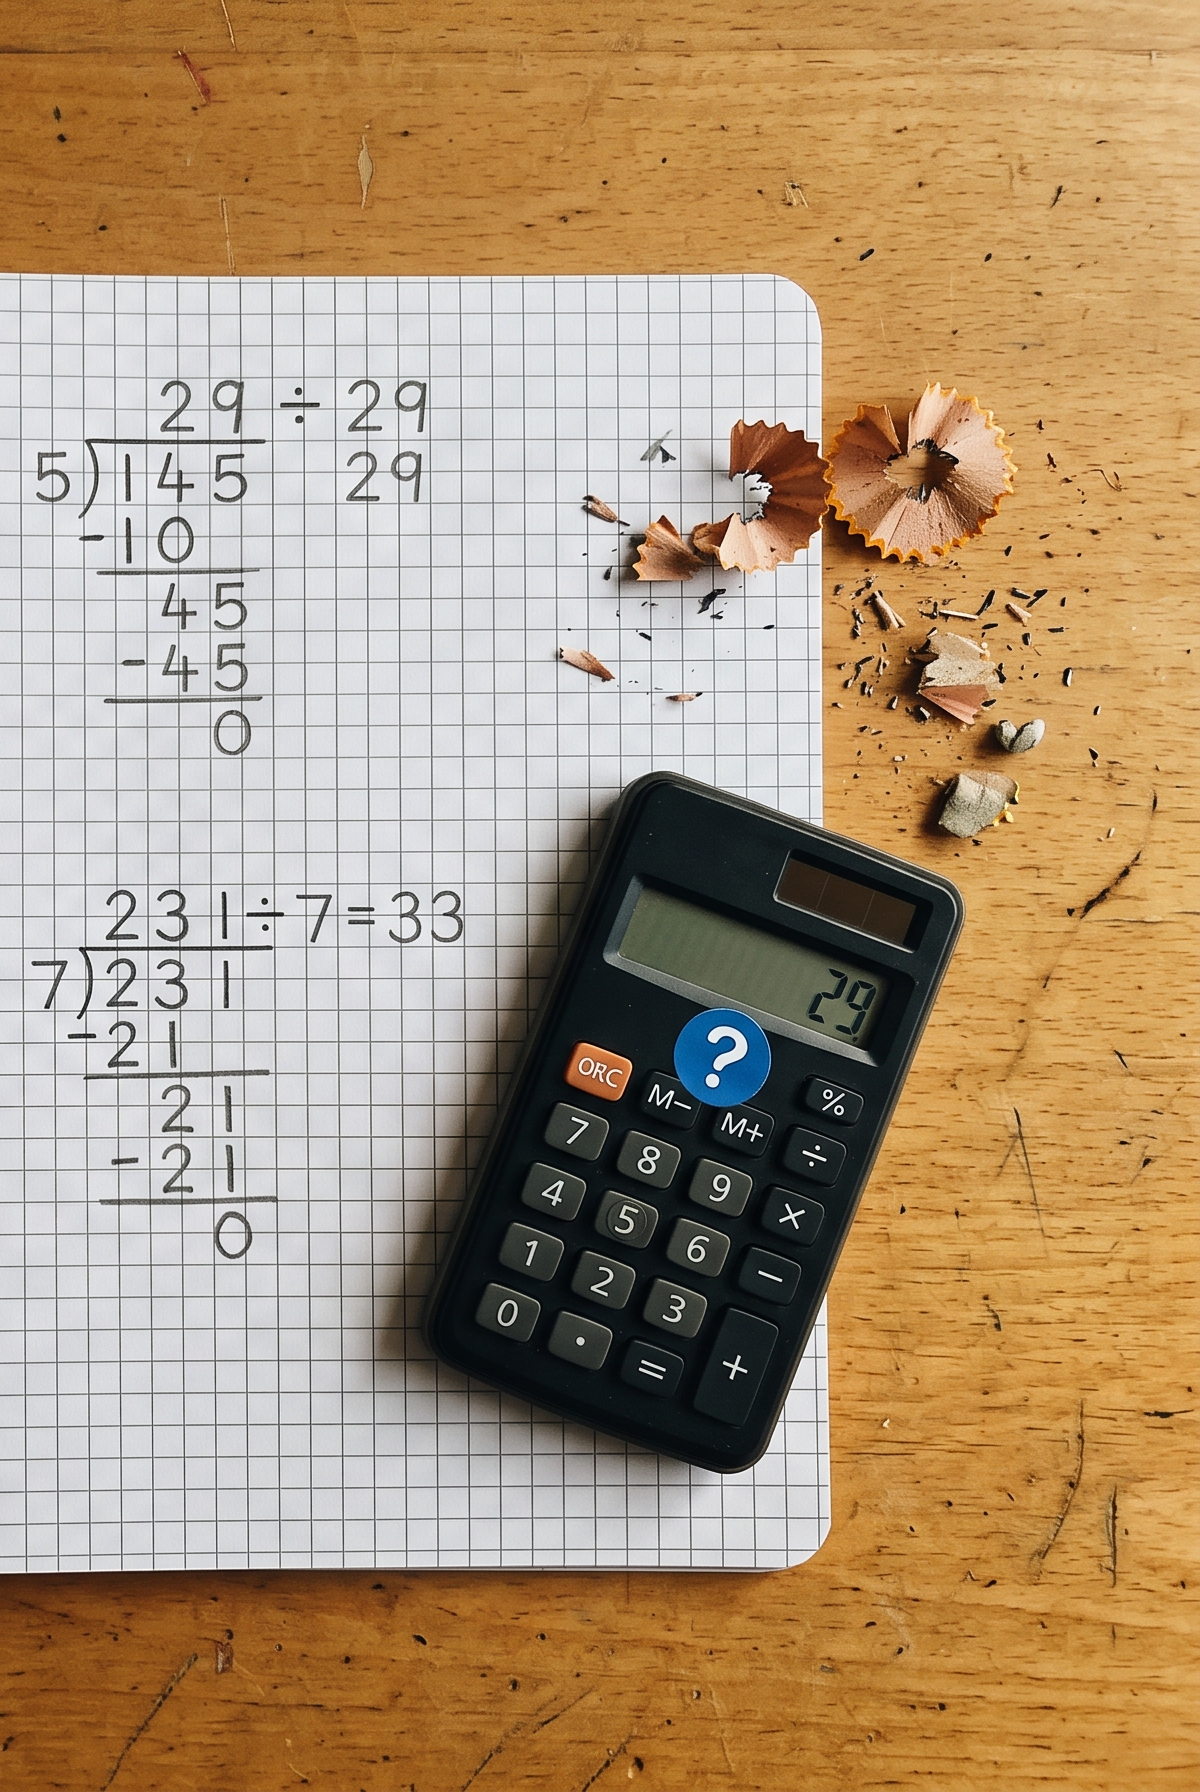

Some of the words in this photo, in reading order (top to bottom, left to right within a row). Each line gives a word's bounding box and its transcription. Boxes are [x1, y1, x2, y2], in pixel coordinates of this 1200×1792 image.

[161, 380, 244, 434] 29
[348, 379, 427, 432] 29
[346, 451, 422, 502] 29
[161, 583, 248, 630] 45
[214, 710, 251, 755] 0
[567, 1116, 590, 1145] 7
[637, 1146, 661, 1174] 8
[541, 1180, 564, 1207] 4
[708, 1174, 732, 1202] 9
[214, 1211, 252, 1259] 0
[614, 1206, 638, 1235] 5
[525, 1240, 539, 1267] 1
[686, 1235, 708, 1263] 6
[590, 1267, 615, 1297] 2
[497, 1300, 518, 1326] 0
[662, 1295, 686, 1323] 3
